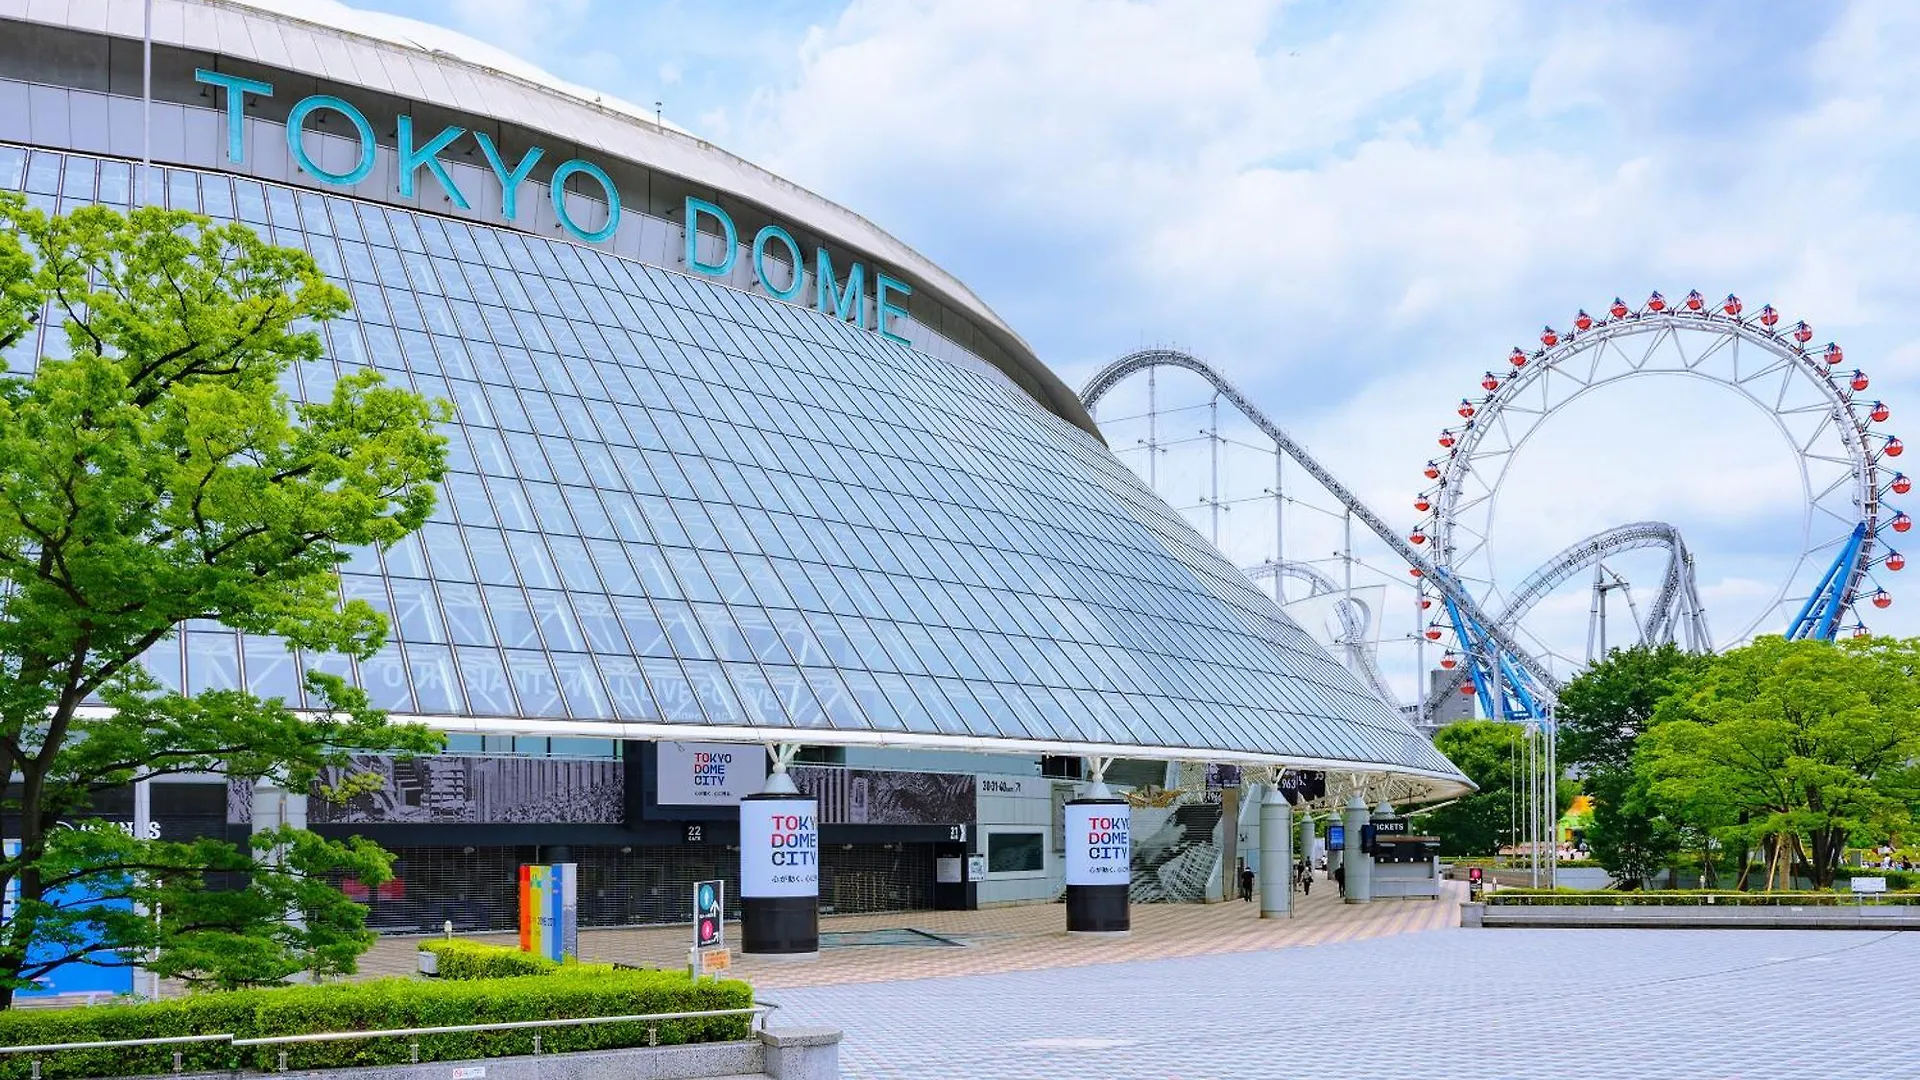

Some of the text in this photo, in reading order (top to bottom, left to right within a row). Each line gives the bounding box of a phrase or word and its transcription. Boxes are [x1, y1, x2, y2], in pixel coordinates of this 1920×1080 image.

[195, 68, 913, 348] TOKYO DOME
[694, 752, 732, 763] TOKYO
[694, 764, 725, 774] DOME
[694, 775, 725, 786] CITY
[688, 825, 701, 836] 22
[771, 833, 816, 849] DOME
[1088, 832, 1128, 845] DOME
[771, 851, 816, 866] CITY
[1088, 847, 1128, 860] CITY
